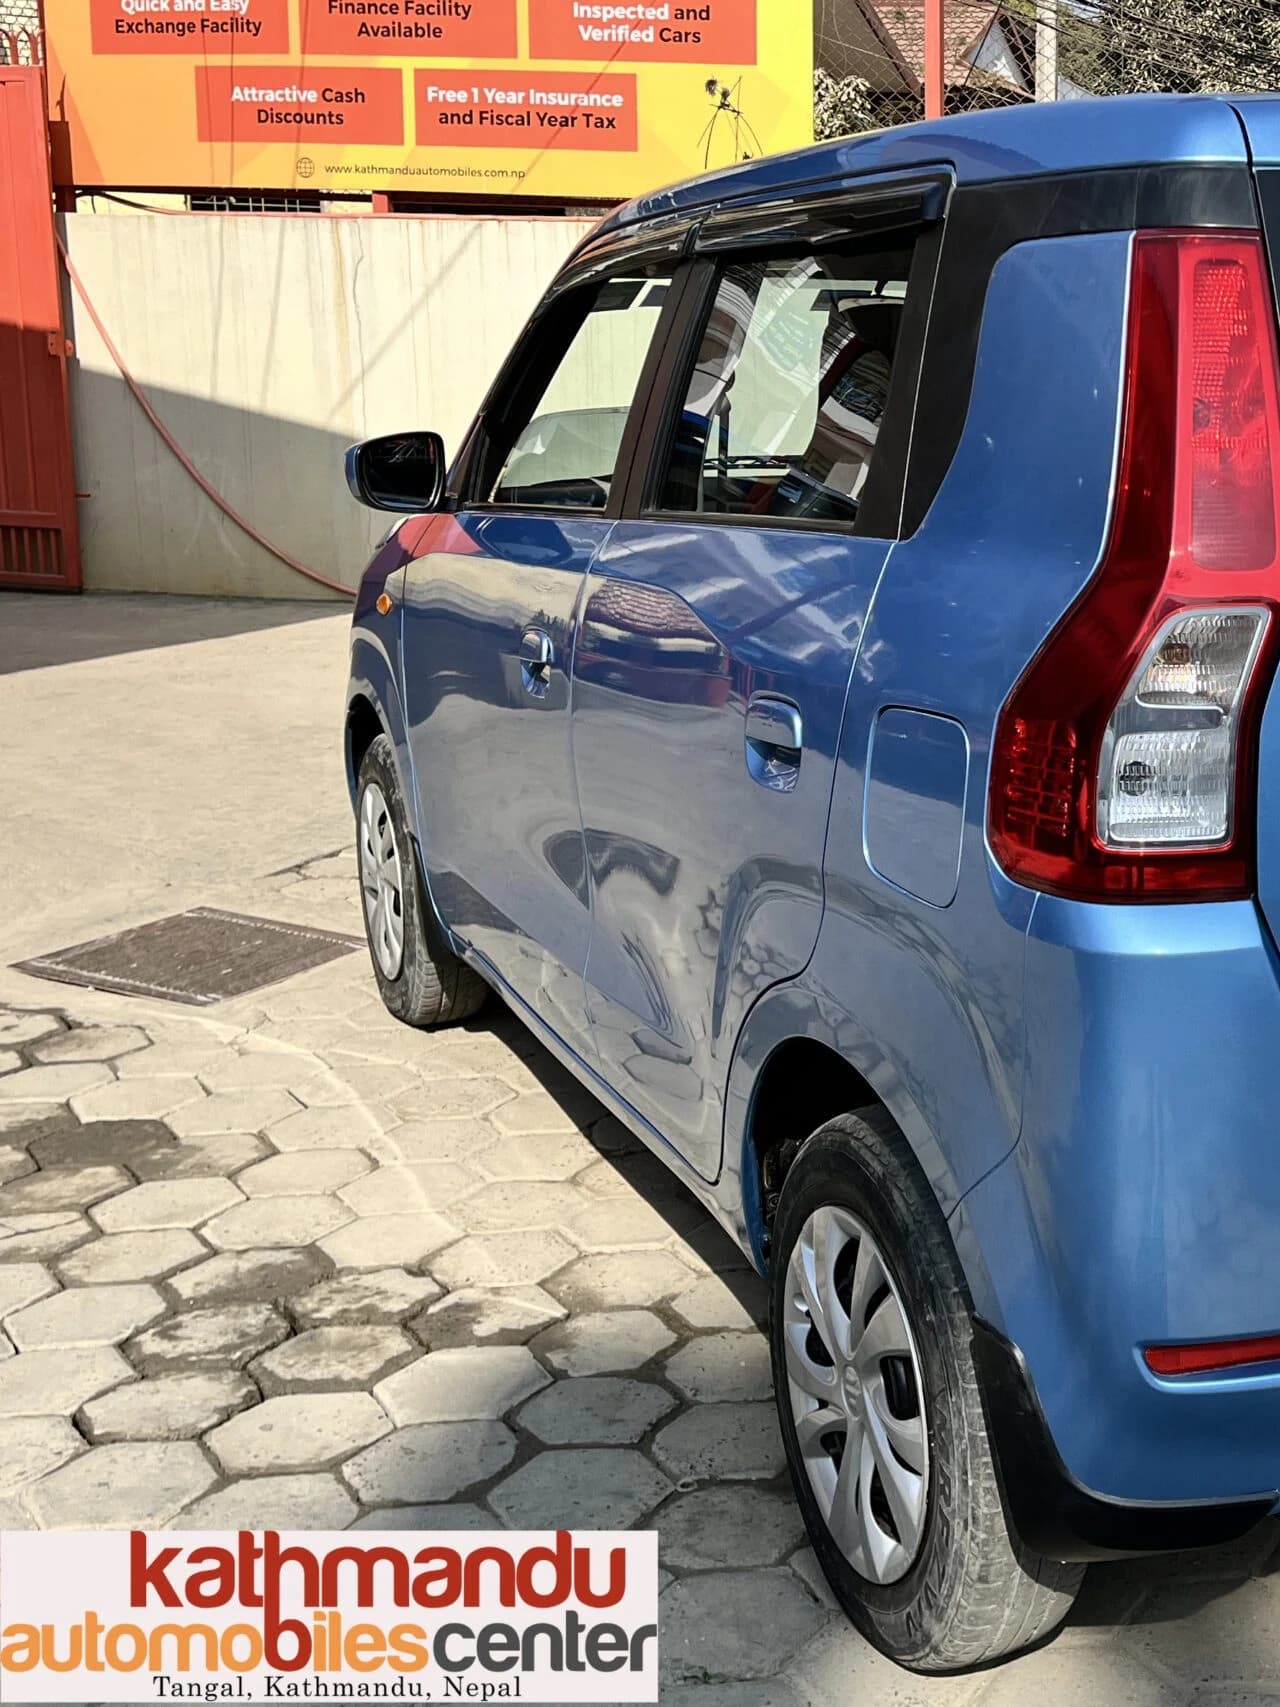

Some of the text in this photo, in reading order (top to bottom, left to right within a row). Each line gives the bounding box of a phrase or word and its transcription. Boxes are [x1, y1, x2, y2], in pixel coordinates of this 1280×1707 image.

[173, 0, 205, 12] and
[210, 0, 250, 15] Easy
[328, 0, 472, 20] Finance Facility
[573, 2, 711, 22] Inspected and
[115, 17, 262, 37] Exchange Facility
[357, 22, 443, 38] Available
[578, 25, 701, 43] Verified Cars
[231, 86, 366, 103] Attractive Cash
[426, 86, 624, 107] Free 1 Year Insurance
[257, 108, 344, 125] Discounts
[439, 110, 616, 129] and Fiscal Year Tax
[324, 164, 526, 179] www.kathmanduautomobiles.com.np
